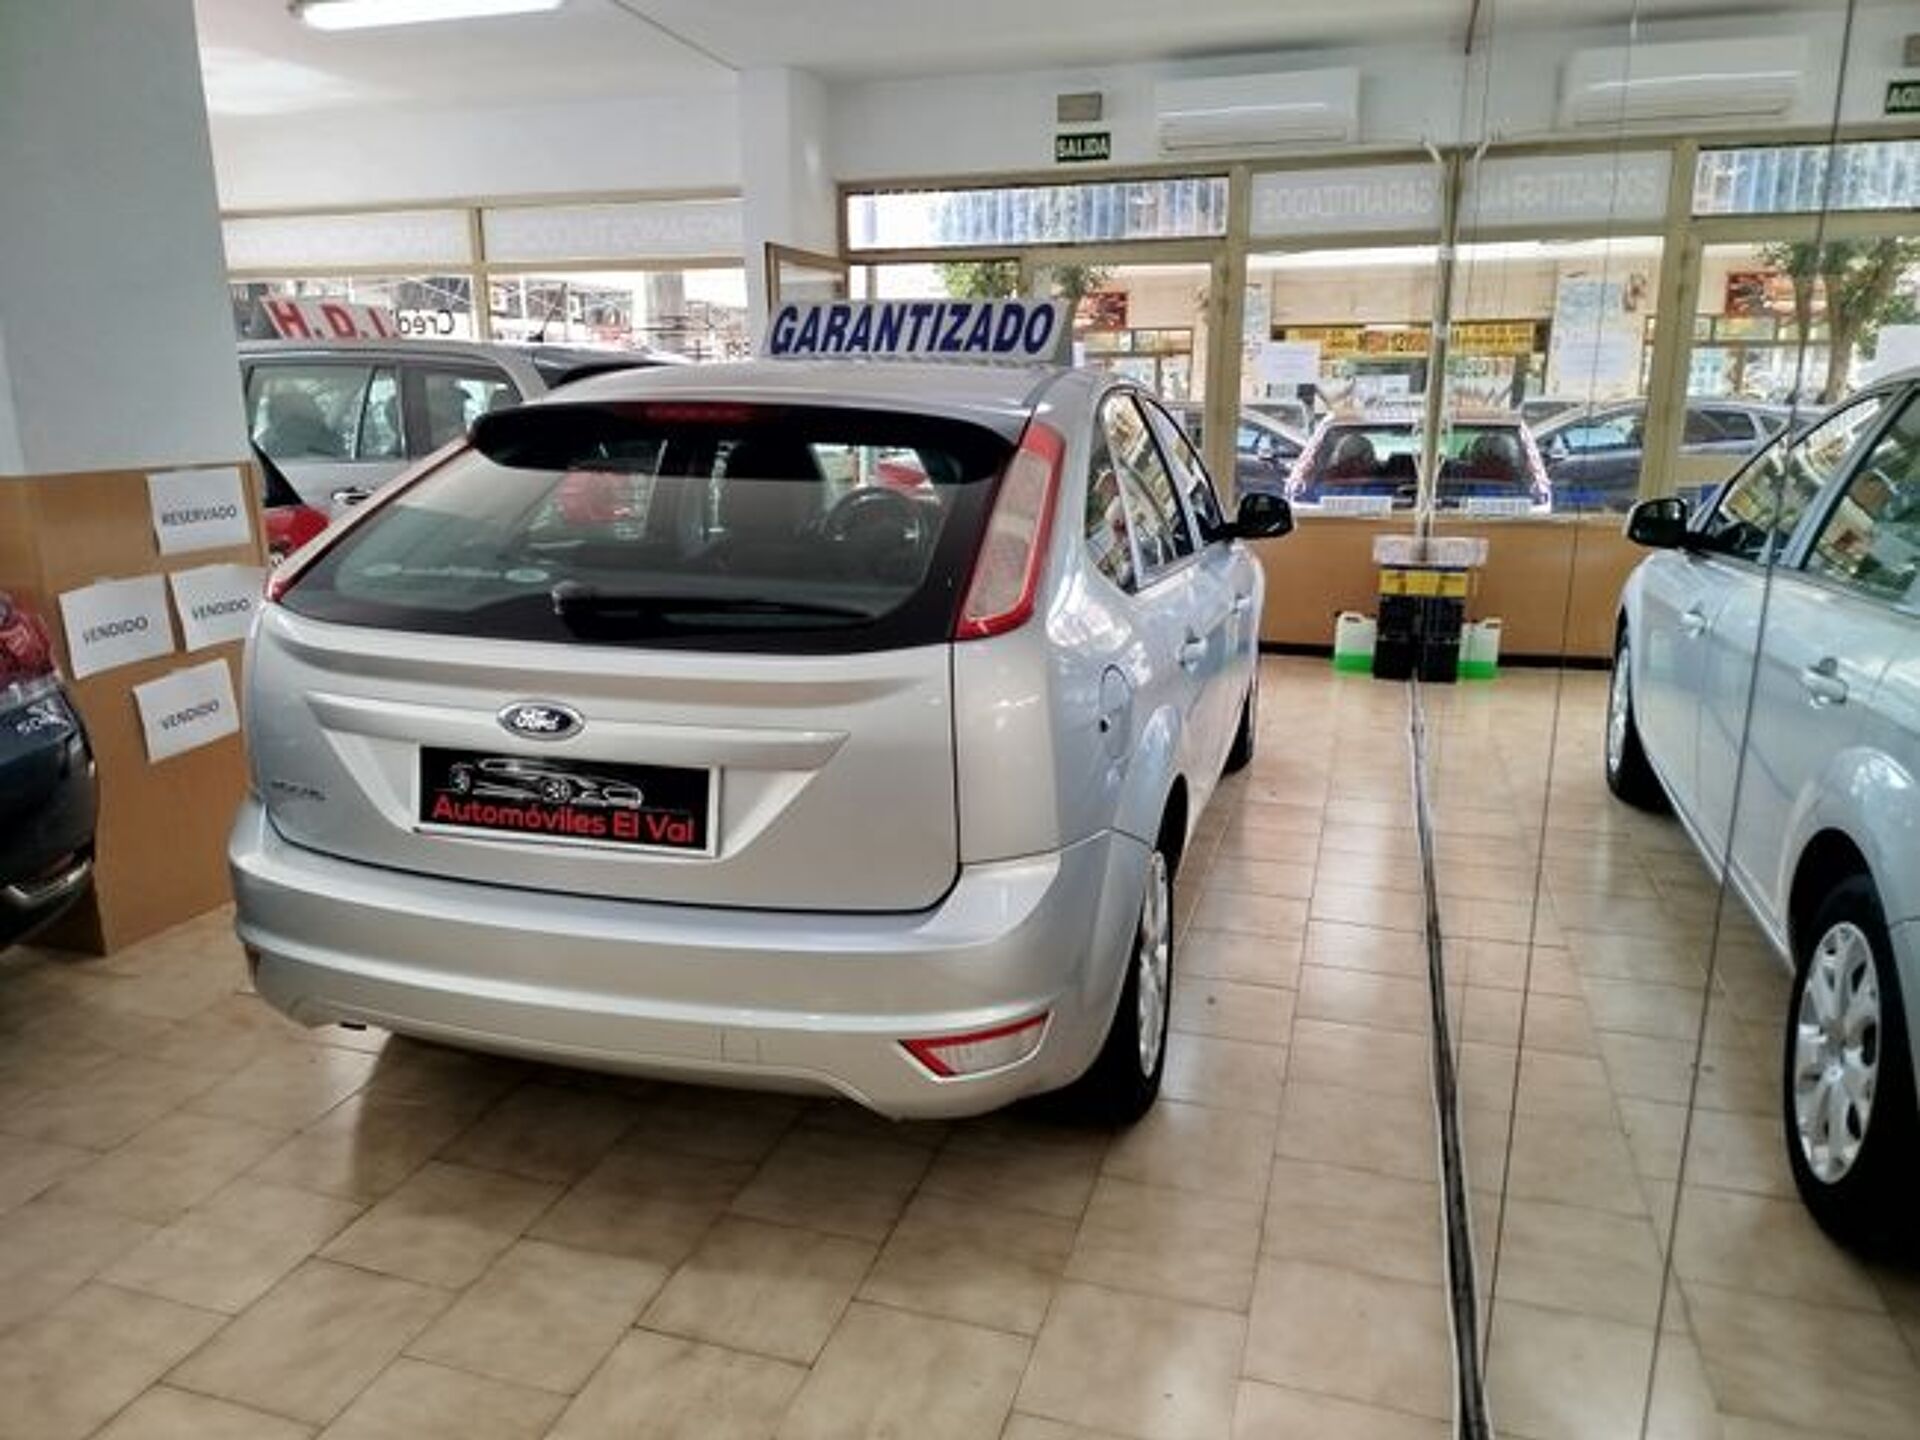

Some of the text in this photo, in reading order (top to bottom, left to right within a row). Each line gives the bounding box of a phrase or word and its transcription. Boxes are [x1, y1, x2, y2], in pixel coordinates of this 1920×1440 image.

[1056, 136, 1109, 157] SALIDA
[770, 303, 1055, 354] GARANTIZADO
[161, 504, 237, 526] RESERVADO
[190, 598, 251, 621] VENDIDO
[81, 615, 149, 645] VENDIDO
[160, 698, 220, 731] VENDIDO
[432, 794, 694, 842] Automóviles El Val
